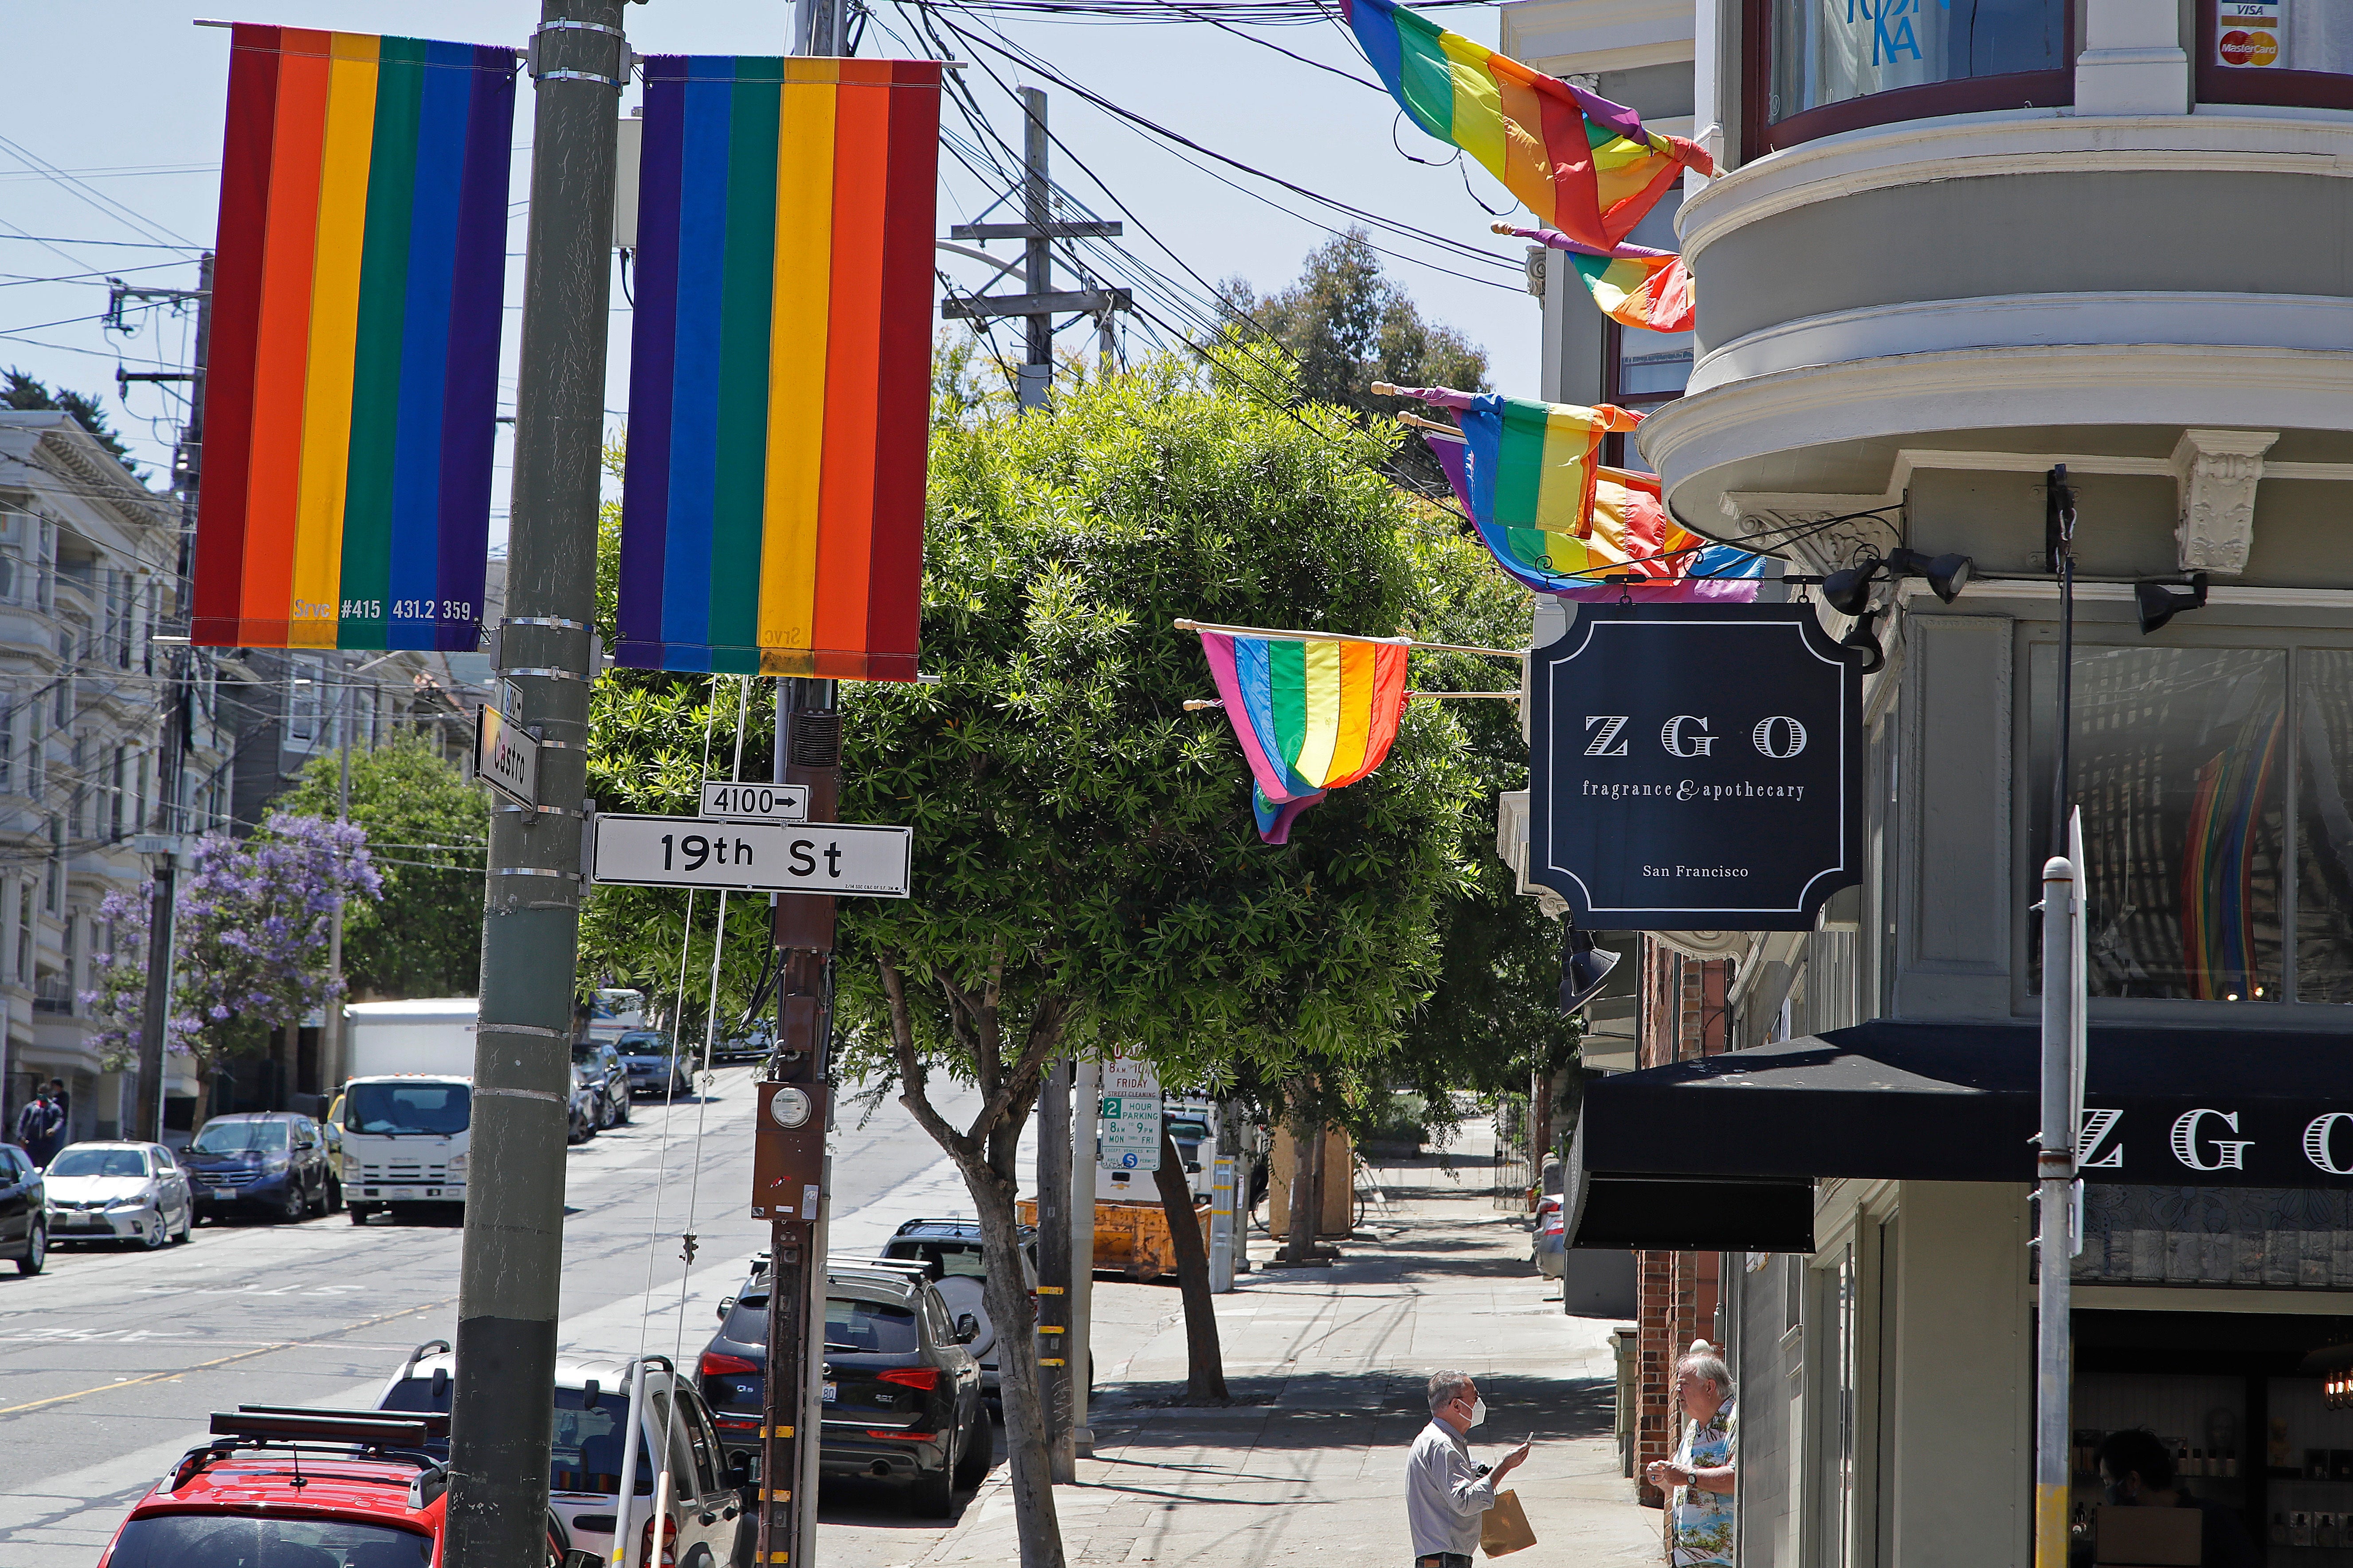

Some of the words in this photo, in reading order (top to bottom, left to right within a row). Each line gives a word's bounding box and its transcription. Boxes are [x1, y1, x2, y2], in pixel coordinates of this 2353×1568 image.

[2237, 4, 2263, 15] VISA
[2221, 43, 2276, 54] MasterCard
[294, 599, 331, 618] Srvc
[341, 600, 380, 619] #415
[392, 600, 435, 619] 431.2
[443, 601, 471, 620] 359
[506, 687, 516, 716] 600
[494, 730, 525, 784] Castro
[713, 788, 773, 813] 4100
[1582, 780, 1672, 800] fragrance
[1703, 781, 1805, 801] apothecary
[661, 834, 753, 872] 19th
[787, 839, 842, 878] St
[1643, 865, 1670, 877] San
[1675, 865, 1749, 878] Francisco
[1117, 1078, 1148, 1088] FRIDAY
[1107, 1101, 1117, 1116] 2
